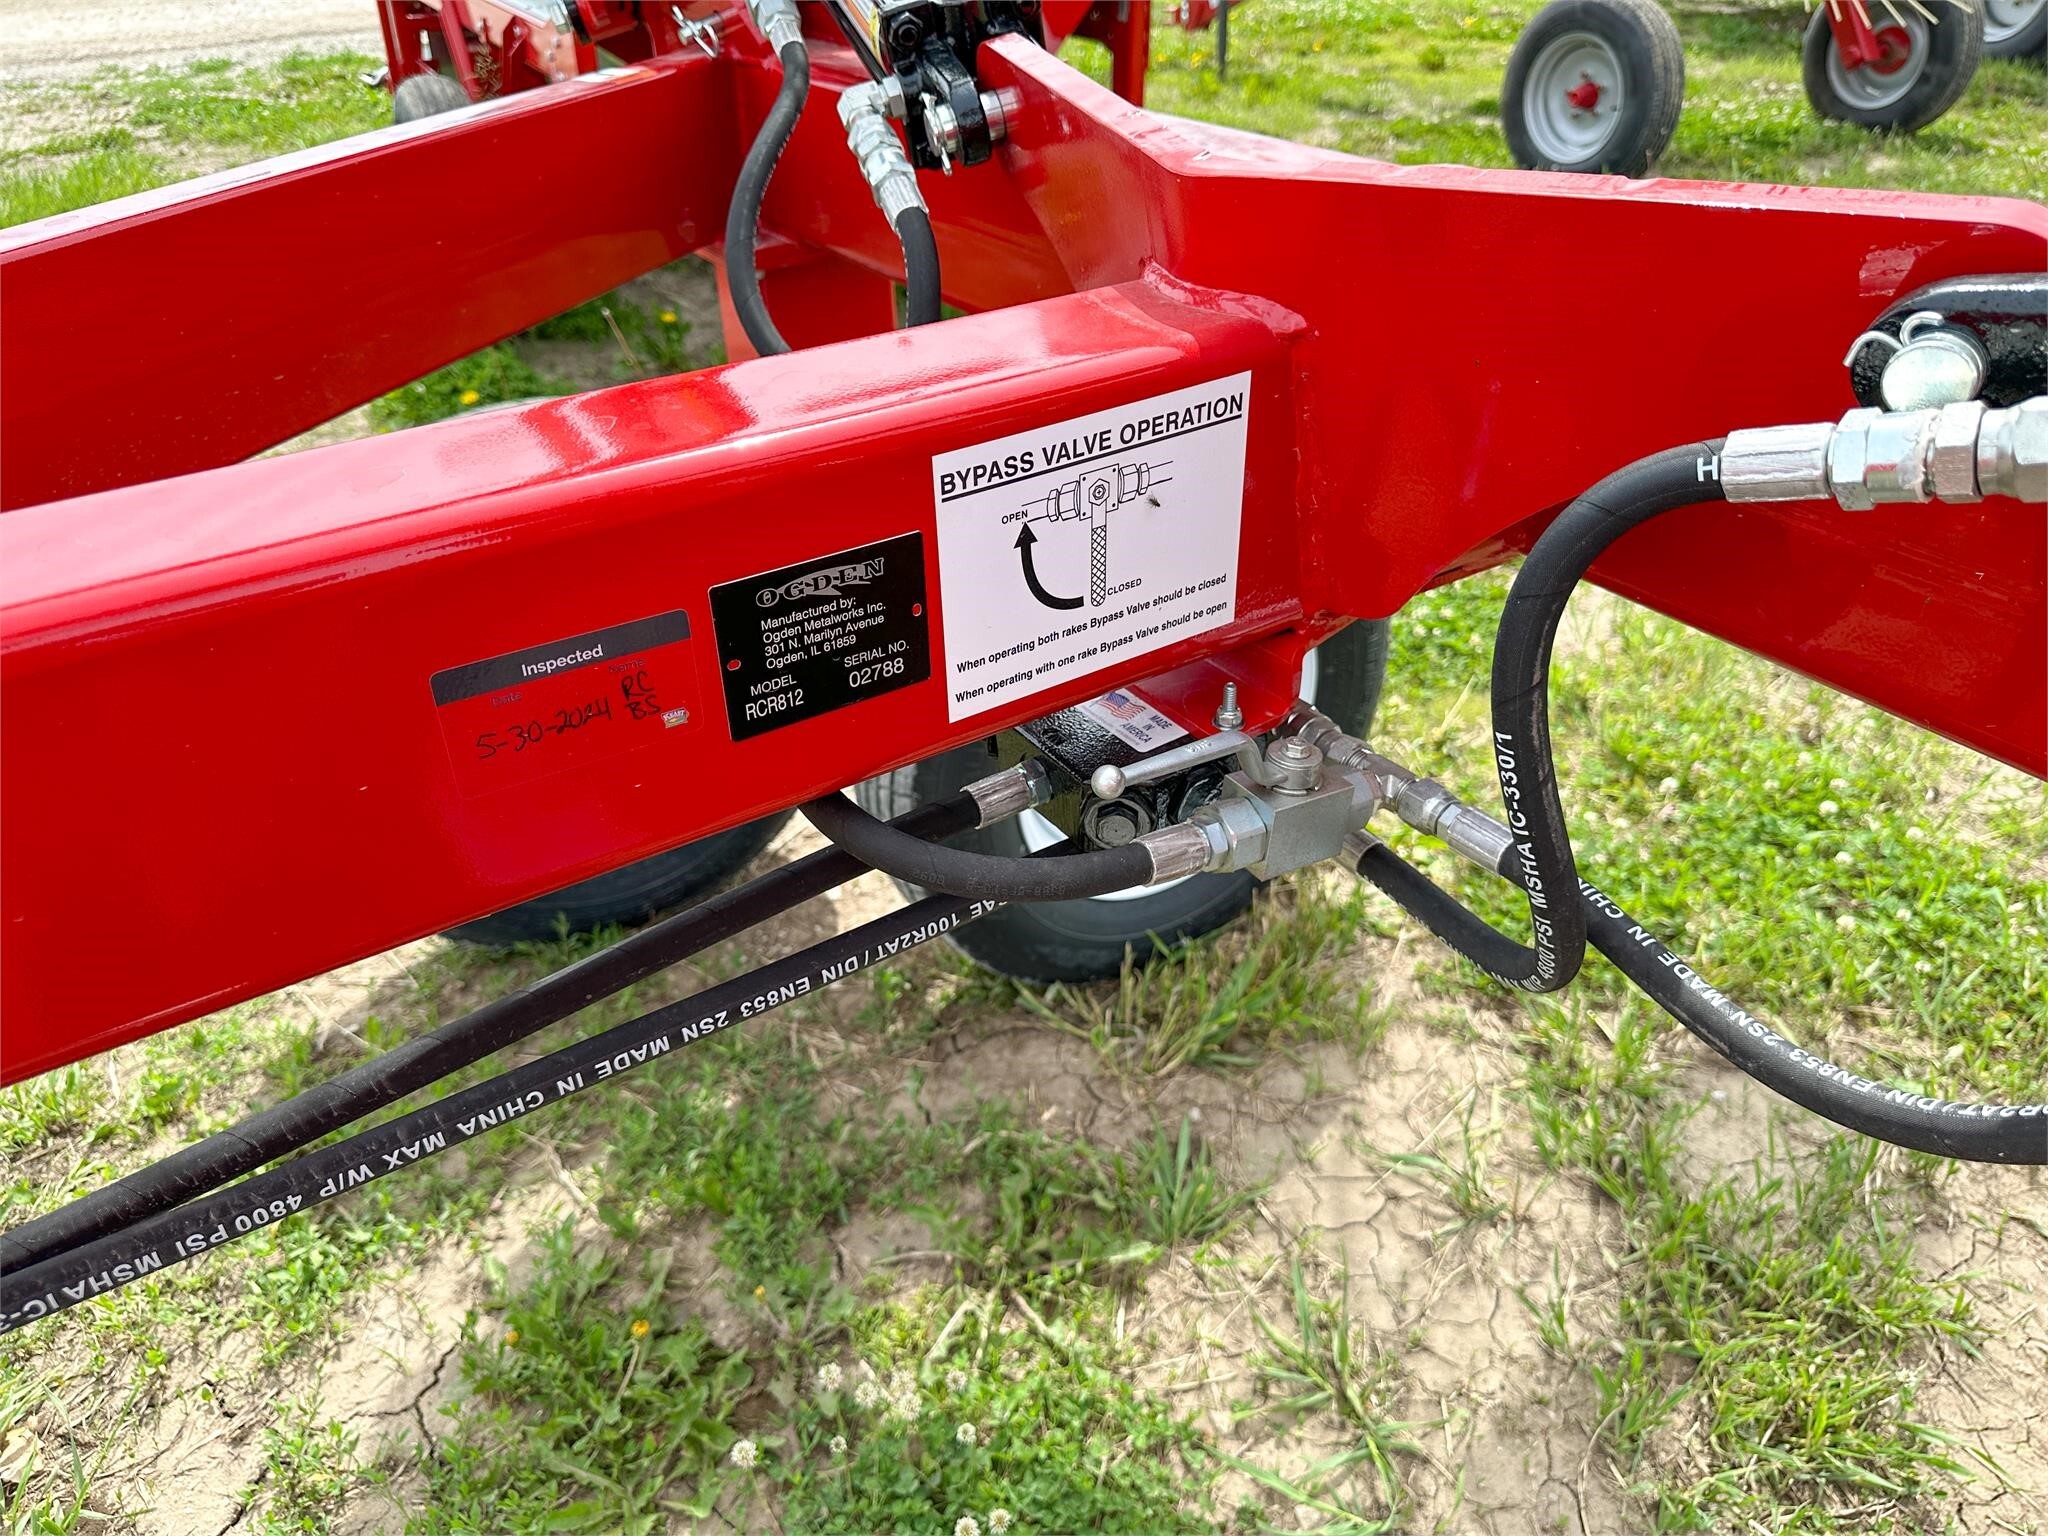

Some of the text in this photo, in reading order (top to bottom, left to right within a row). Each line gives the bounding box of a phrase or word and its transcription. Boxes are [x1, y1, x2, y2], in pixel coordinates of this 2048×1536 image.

[940, 392, 1243, 496] BYPASS VALVE OPERATION
[1001, 510, 1028, 525] OPEN
[1107, 578, 1142, 596] CLOSED
[760, 597, 857, 631] Manufactured by:
[762, 601, 886, 644] Ogden Metalworks Inc.
[957, 574, 1226, 673] When operating both rakes Bypass Valve should be closed
[764, 614, 885, 657] 301 N. Marilyn Avenue
[766, 634, 857, 670] Ogden, IL 61859
[521, 644, 604, 677] Inspected
[844, 640, 910, 668] SERIAL NO.
[956, 602, 1227, 703] When operating with one rake Bypass Valve should be open
[750, 674, 797, 697] MODEL
[849, 658, 905, 688] 02788
[745, 688, 804, 721] RCR812
[475, 697, 612, 759] 5-30-2024
[1120, 722, 1153, 743] AMERICA
[1144, 722, 1153, 731] IN
[1150, 714, 1173, 730] MADE
[1495, 731, 1527, 836] IC-330/1
[1516, 843, 1548, 909] MSHA
[970, 900, 1008, 919] AE
[876, 914, 961, 963] 100R2AT
[1536, 915, 1554, 948] PSI
[1627, 925, 1656, 947] IN
[821, 956, 858, 985] DIN
[1536, 949, 1556, 981] 4800
[1658, 951, 1728, 1008] MADE
[739, 976, 810, 1018] EN853
[681, 1010, 730, 1043] 2SN
[1729, 1010, 1785, 1046] 2SN
[594, 1035, 671, 1079] MADE
[1789, 1048, 1877, 1093] EN853
[556, 1072, 585, 1096] IN
[1884, 1089, 1940, 1111] DIN
[456, 1091, 544, 1136] CHINA
[383, 1131, 447, 1170] MAX
[319, 1166, 375, 1198] W/P
[234, 1195, 303, 1232] 4800
[175, 1225, 228, 1257] PSI
[62, 1252, 163, 1301] MSHA
